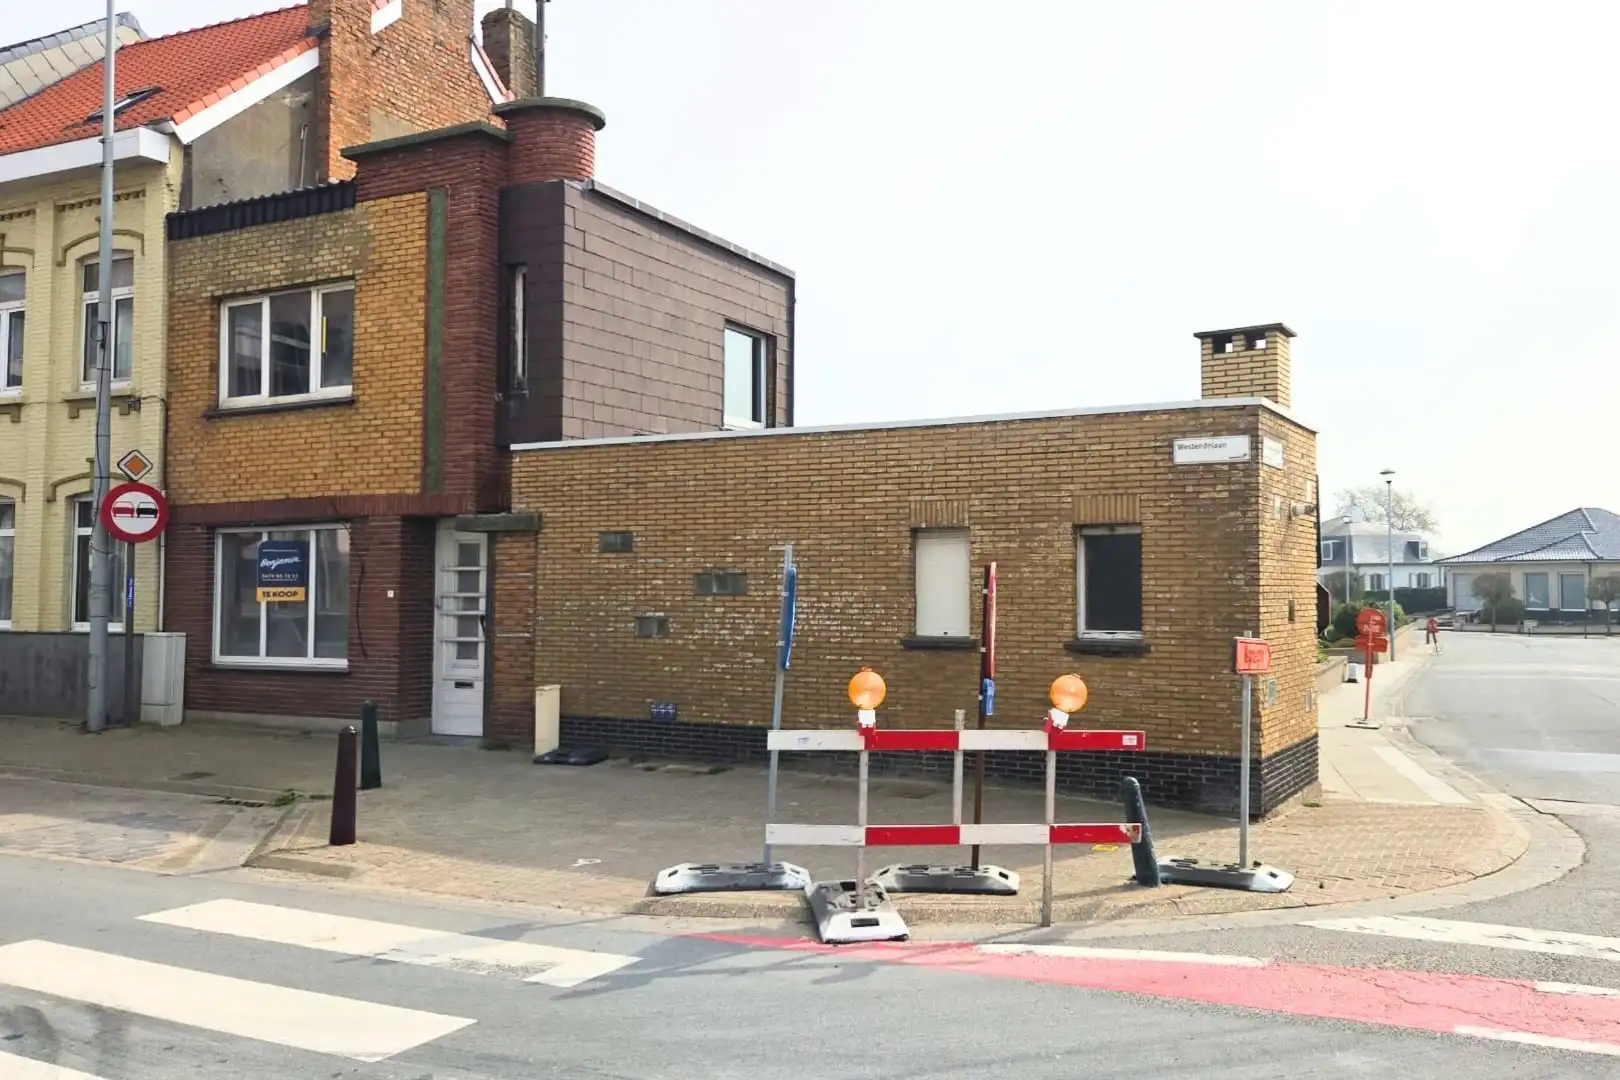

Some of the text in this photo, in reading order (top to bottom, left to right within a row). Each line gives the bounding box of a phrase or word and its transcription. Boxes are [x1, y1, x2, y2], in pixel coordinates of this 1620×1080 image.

[260, 556, 302, 570] Benjamin
[262, 590, 299, 599] TE KOOP
